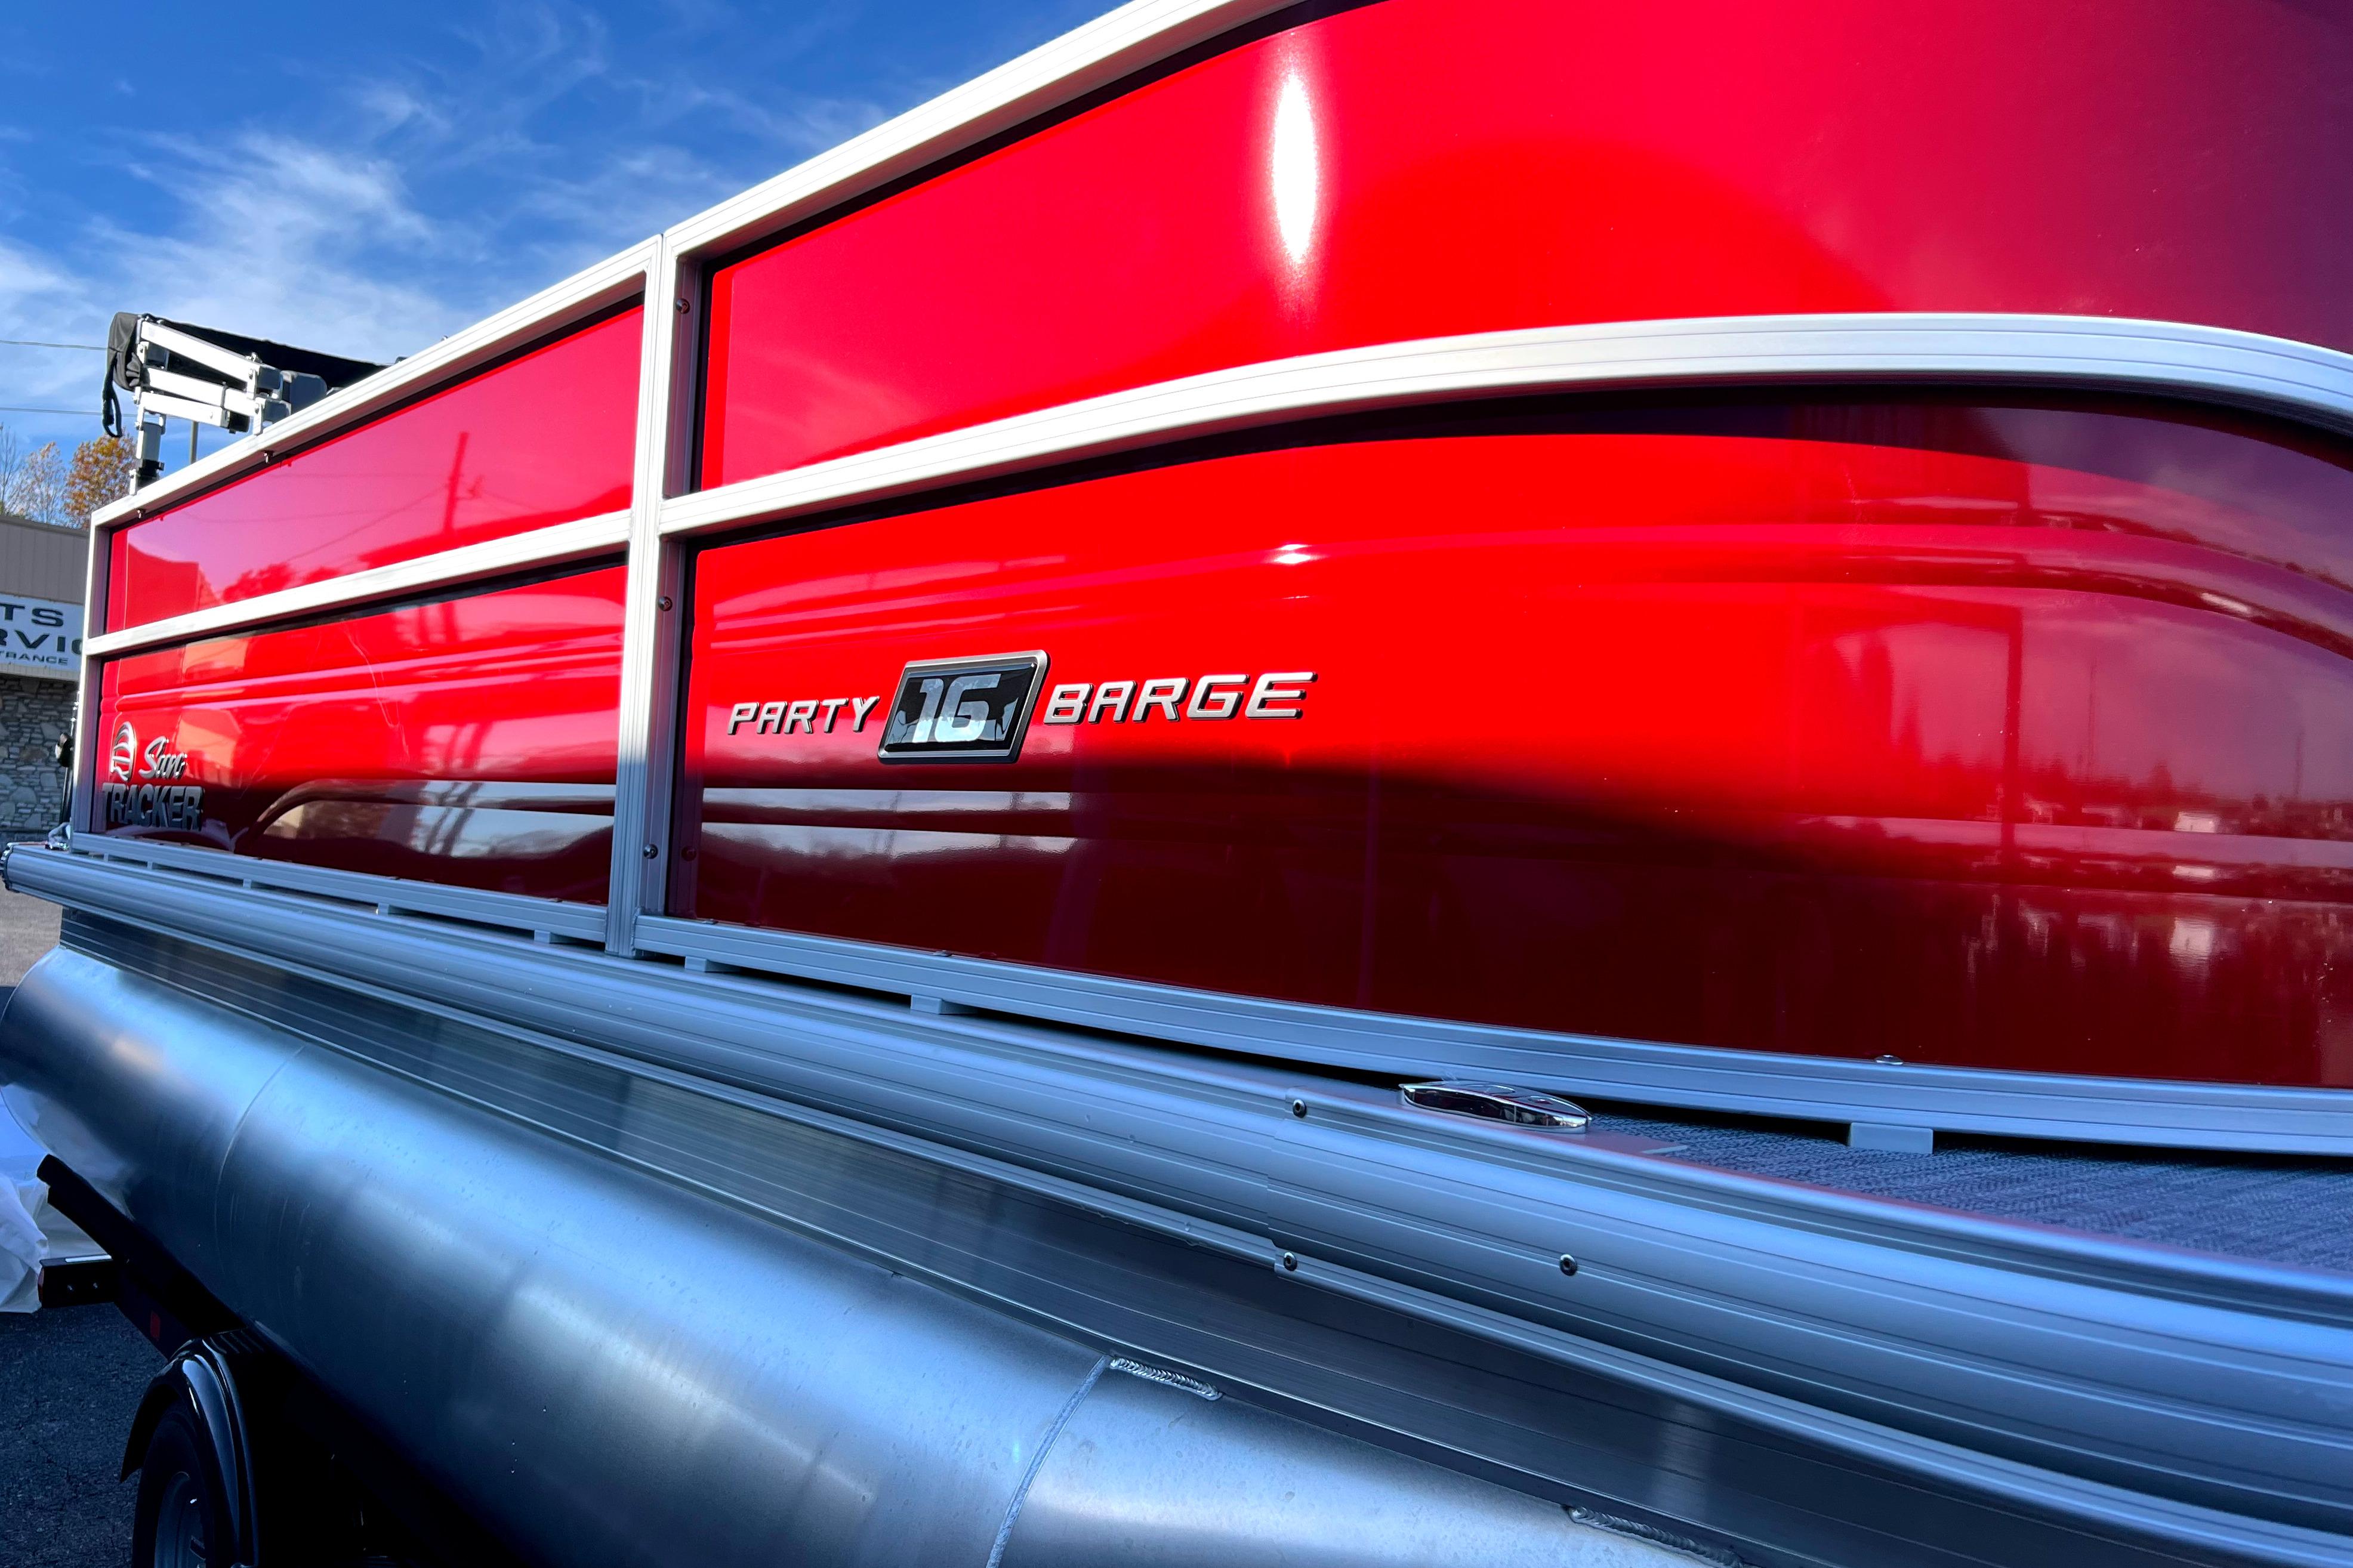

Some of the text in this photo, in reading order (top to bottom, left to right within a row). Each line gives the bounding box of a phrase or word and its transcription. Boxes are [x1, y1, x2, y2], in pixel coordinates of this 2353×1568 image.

[727, 671, 1317, 743] PARTY 16 BARGE
[138, 736, 187, 779] Sun
[102, 782, 205, 832] TRACKER
